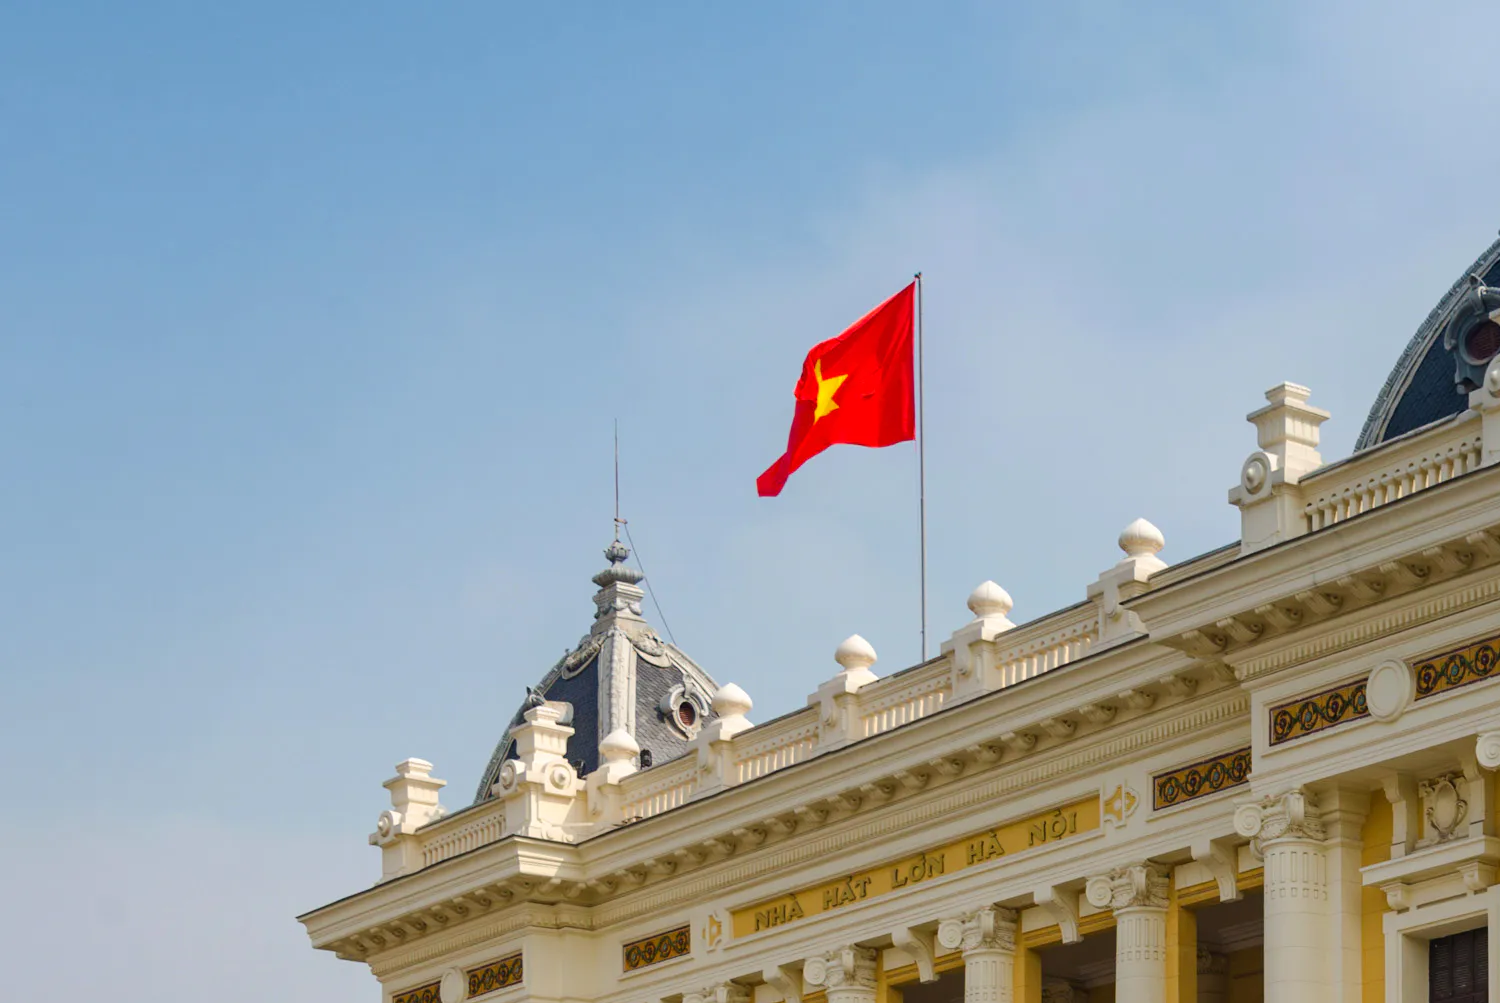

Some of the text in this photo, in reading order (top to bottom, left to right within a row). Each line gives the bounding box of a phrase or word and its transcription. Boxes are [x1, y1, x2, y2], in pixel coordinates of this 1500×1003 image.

[754, 809, 1078, 931] NHÀ HÁT LỚN HÀ NỘI
